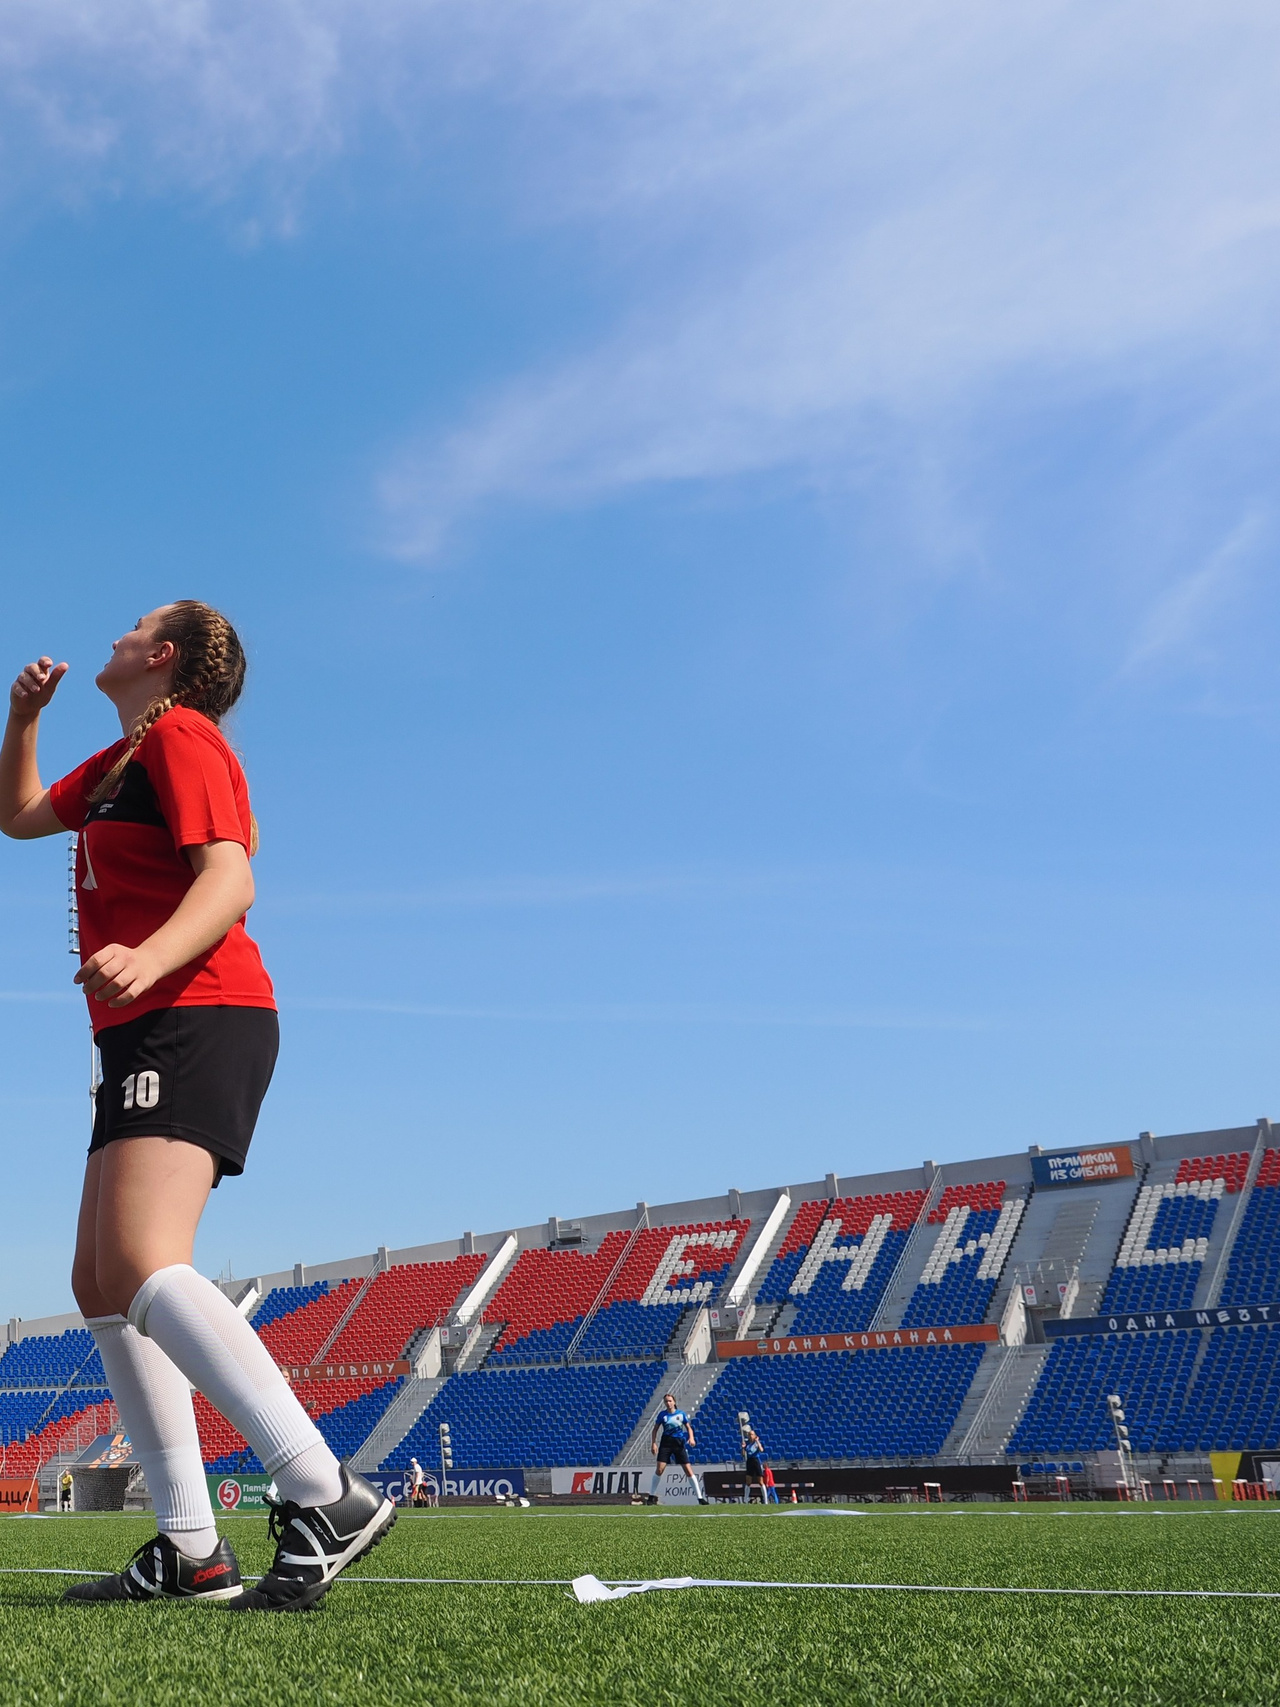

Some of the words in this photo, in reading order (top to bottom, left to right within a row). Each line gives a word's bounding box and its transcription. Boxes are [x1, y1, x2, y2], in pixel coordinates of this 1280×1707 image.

[121, 1070, 160, 1110] 10
[1048, 1152, 1116, 1169] ПРЯМИКОМ
[1050, 1169, 1068, 1181] ИЗ
[1069, 1163, 1118, 1179] СИБИРИ
[1108, 1313, 1176, 1331] ОДНА
[1195, 1306, 1280, 1325] МЕЧТ
[773, 1337, 828, 1352] ОДНА
[844, 1329, 953, 1347] КОМАНДА
[592, 1472, 643, 1494] АГАТ
[190, 1562, 233, 1587] JÖGEL
